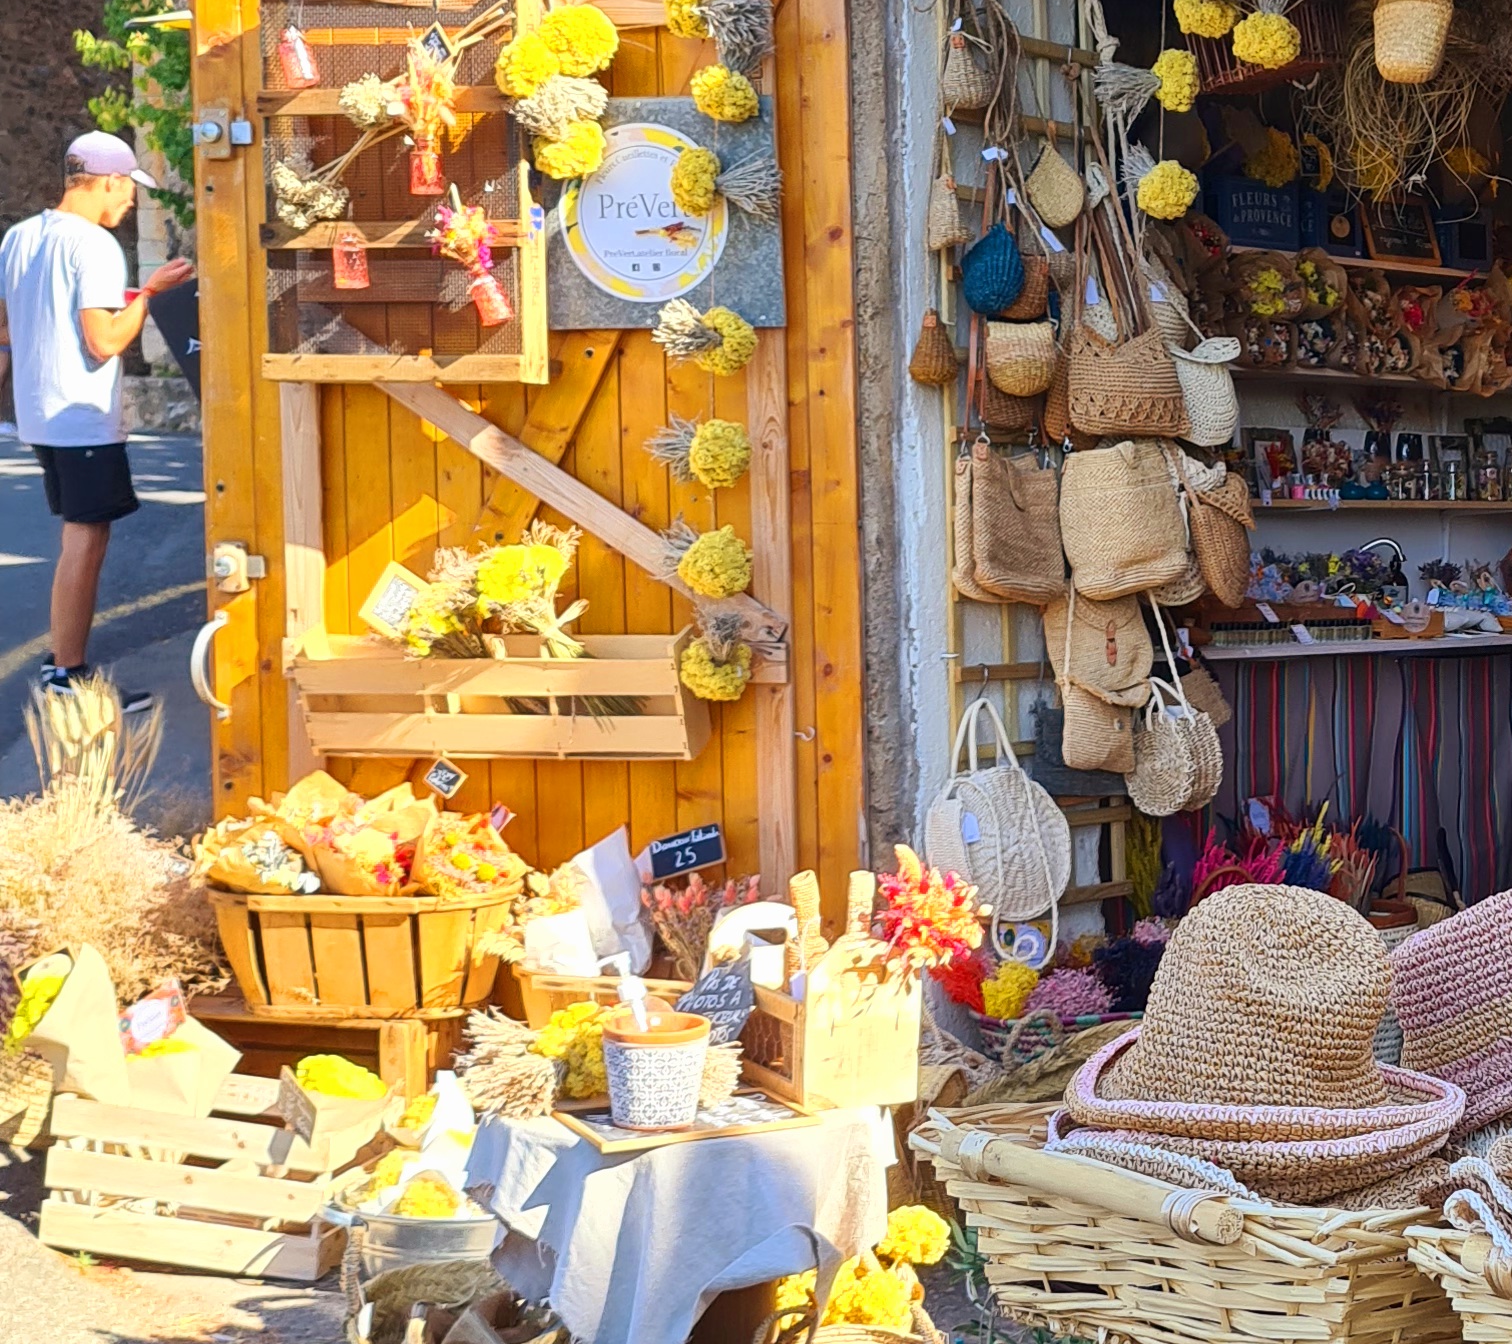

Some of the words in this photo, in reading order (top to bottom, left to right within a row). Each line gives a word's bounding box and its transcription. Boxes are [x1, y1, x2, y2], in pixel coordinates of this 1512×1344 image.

[1232, 192, 1277, 207] FLEURS
[1241, 209, 1292, 227] PROVENCE
[675, 846, 697, 868] 25
[676, 990, 726, 1012] PHOTOS
